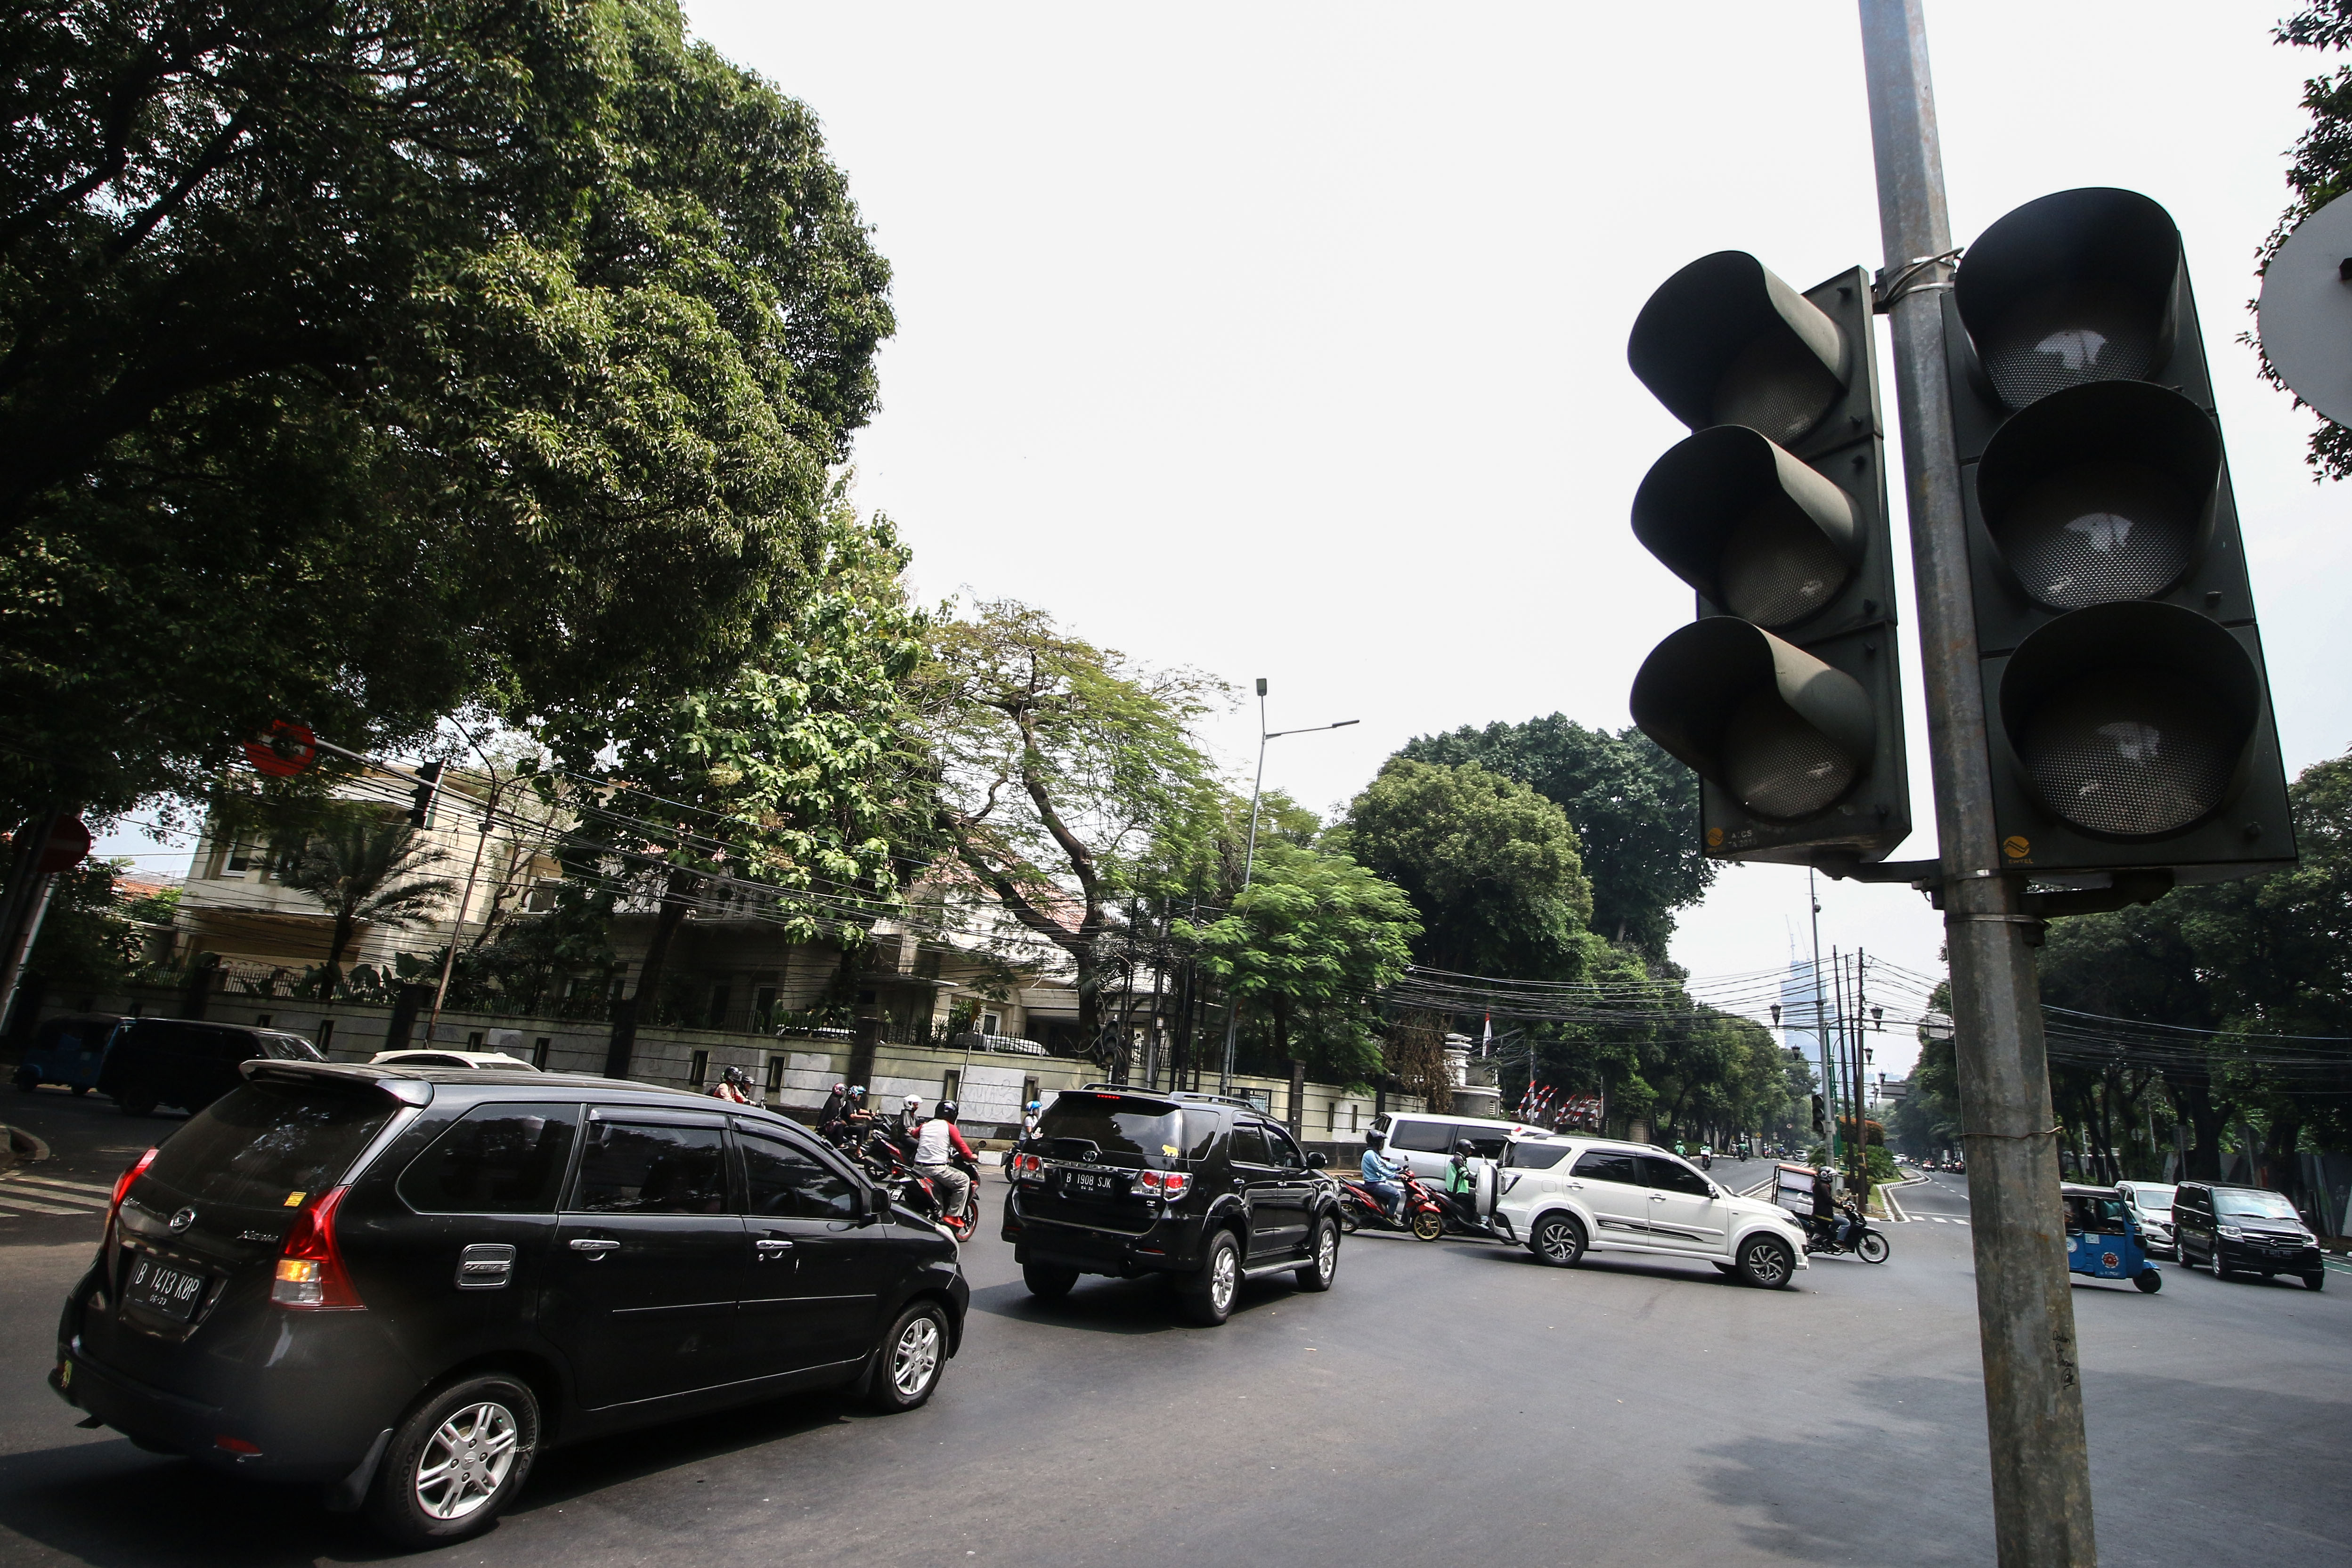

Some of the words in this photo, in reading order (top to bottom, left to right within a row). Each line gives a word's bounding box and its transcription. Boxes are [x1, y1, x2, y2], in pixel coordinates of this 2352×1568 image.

[1732, 830, 1752, 839] ACS
[1066, 1173, 1072, 1183] B
[1077, 1174, 1094, 1186] 1908
[1098, 1177, 1112, 1188] SJK
[135, 1263, 148, 1284] B
[150, 1267, 178, 1294] 1413
